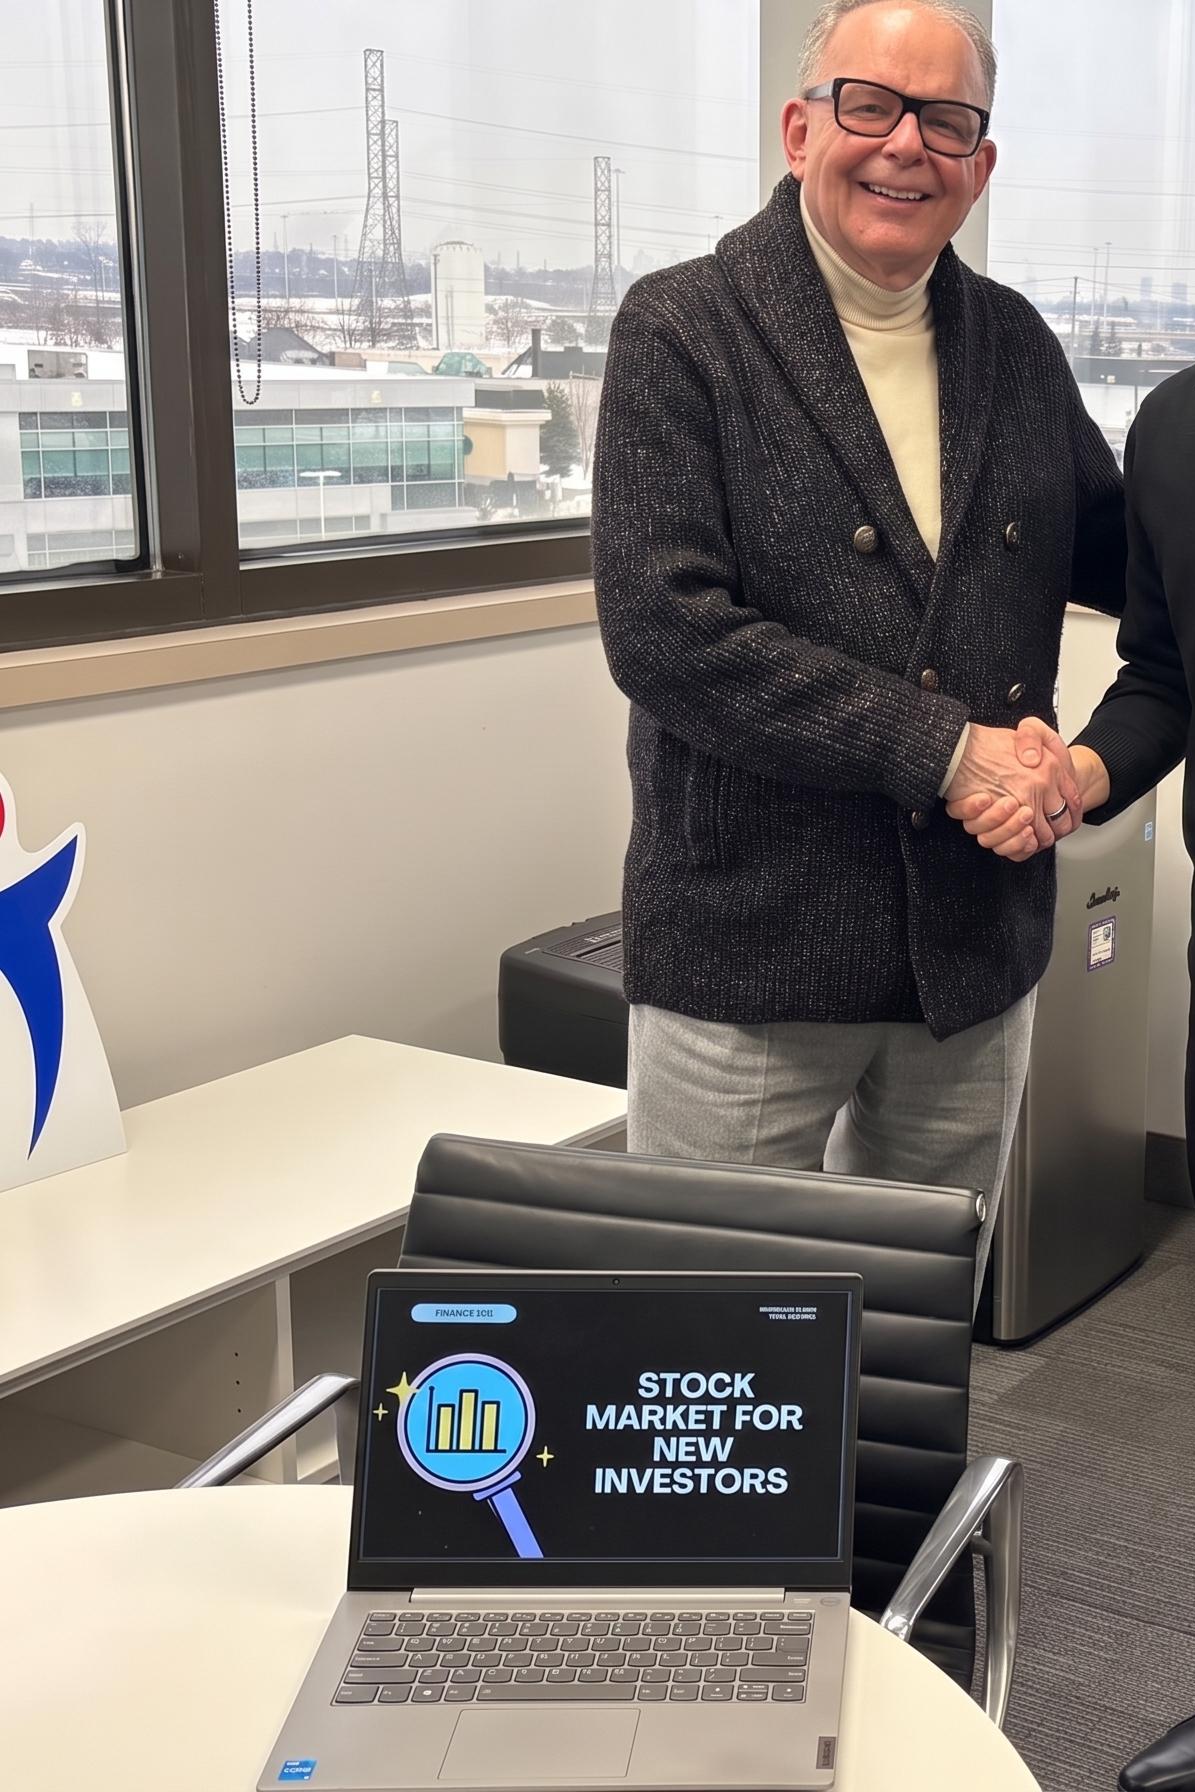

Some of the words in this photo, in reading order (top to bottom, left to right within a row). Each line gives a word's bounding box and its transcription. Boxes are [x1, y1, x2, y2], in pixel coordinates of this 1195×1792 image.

[435, 1308, 475, 1318] FINANCE
[637, 1371, 756, 1399] STOCK
[585, 1404, 728, 1430] MARKET
[734, 1405, 803, 1431] FOR
[653, 1436, 734, 1462] NEW
[594, 1467, 789, 1495] INVESTORS
